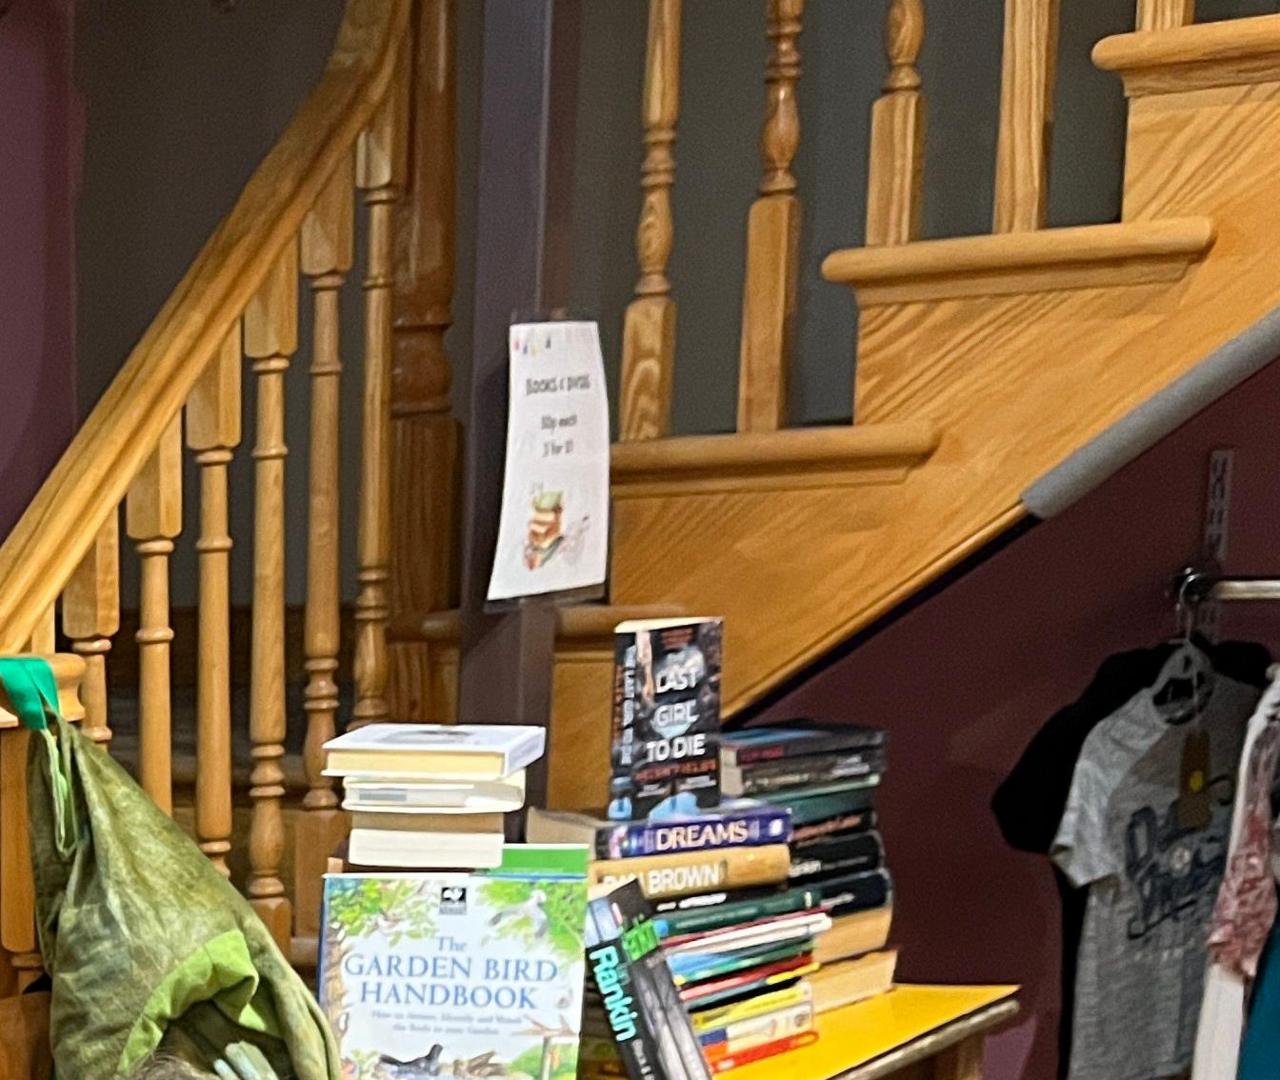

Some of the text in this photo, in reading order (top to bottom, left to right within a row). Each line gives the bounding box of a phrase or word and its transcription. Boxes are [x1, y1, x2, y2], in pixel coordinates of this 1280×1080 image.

[656, 667, 698, 694] LAST
[646, 734, 706, 763] TO DIE
[656, 820, 749, 850] DREAMS
[648, 862, 721, 895] BROWN
[438, 936, 466, 952] The
[344, 953, 558, 982] GARDEN BIRD
[361, 981, 537, 1009] HANDBOOK
[589, 945, 638, 1042] Rankin
